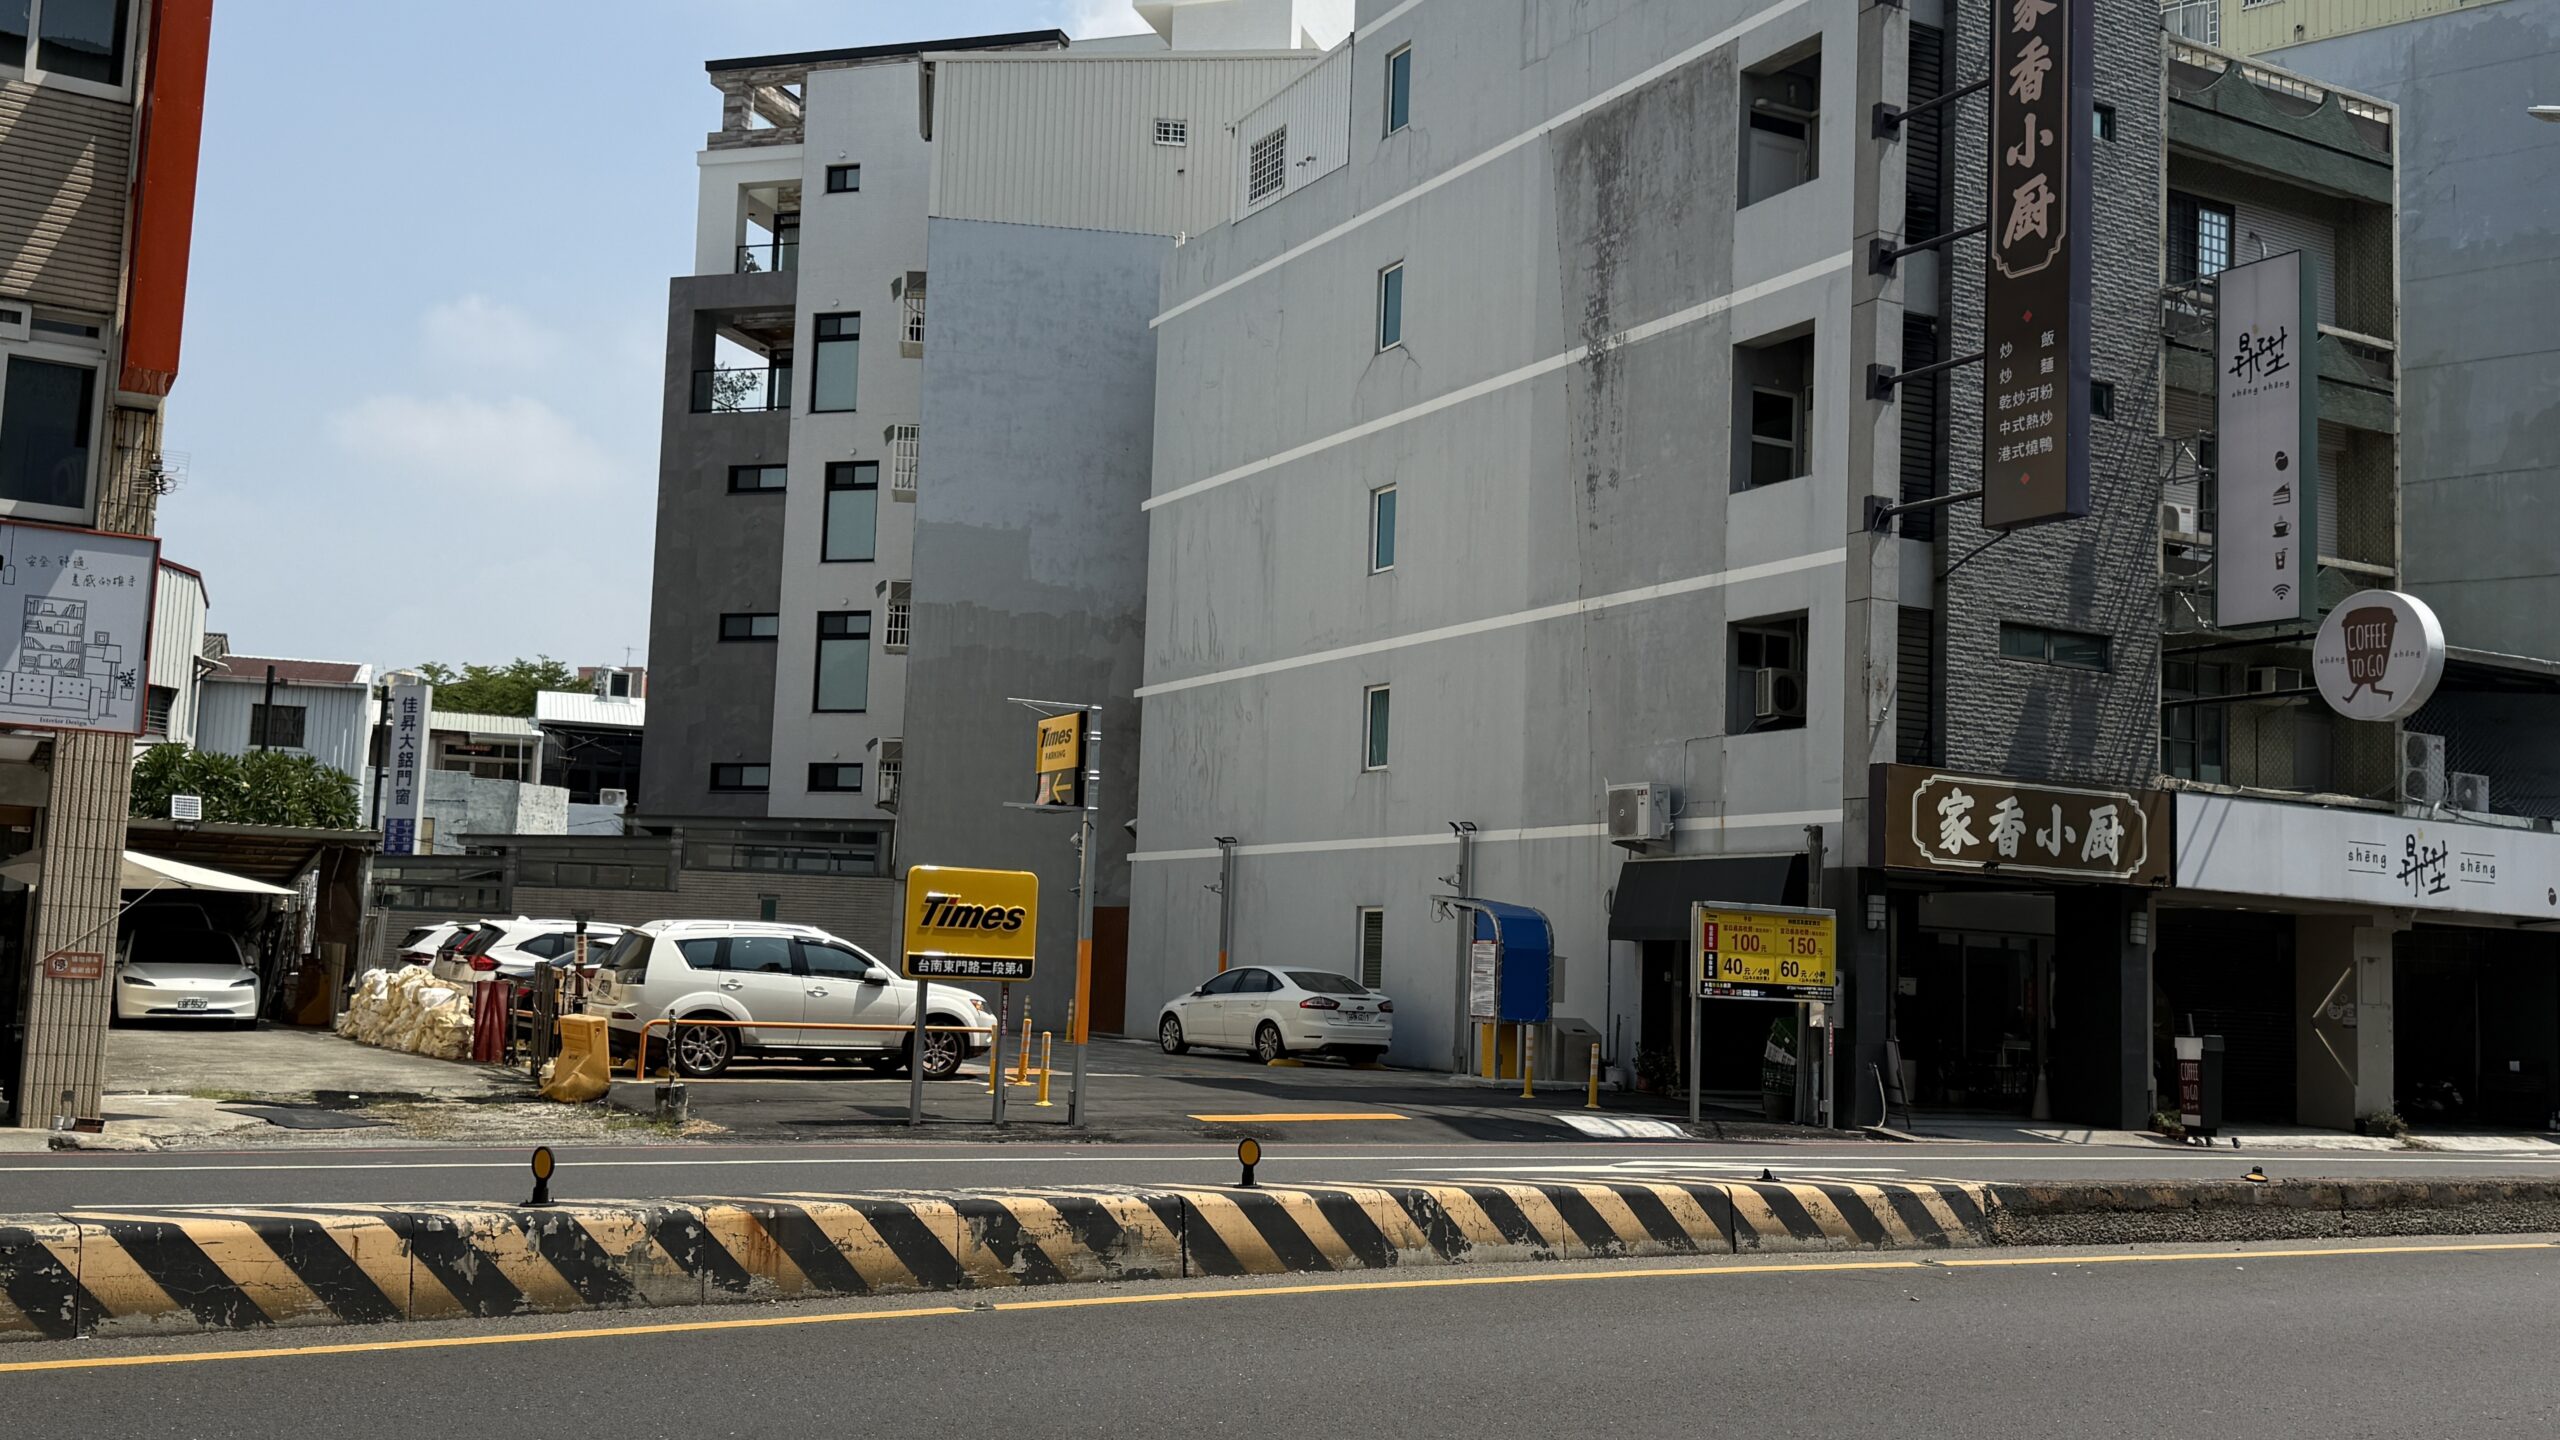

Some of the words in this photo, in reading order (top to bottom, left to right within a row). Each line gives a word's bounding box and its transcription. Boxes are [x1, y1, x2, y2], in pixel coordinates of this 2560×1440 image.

[2000, 341, 2013, 359] 炒
[2041, 330, 2055, 348] 飯
[2000, 367, 2012, 384] 炒
[1999, 383, 2053, 410] 乾炒河粉
[2000, 409, 2053, 435] 中式熱炒
[1998, 436, 2053, 462] 港式燒鴨
[2347, 622, 2388, 651] COFFEE
[2352, 658, 2365, 678] TO
[2367, 654, 2384, 677] GO
[1041, 726, 1073, 749] Times
[396, 697, 418, 805] 佳昇大鋁門窗
[1937, 787, 2125, 866] 家香小厨
[2348, 848, 2387, 869] shēng
[2460, 858, 2496, 879] shēng
[920, 893, 1026, 931] Times
[918, 959, 1024, 975] 台南東門路二段第4
[2181, 1062, 2199, 1081] COFFEE
